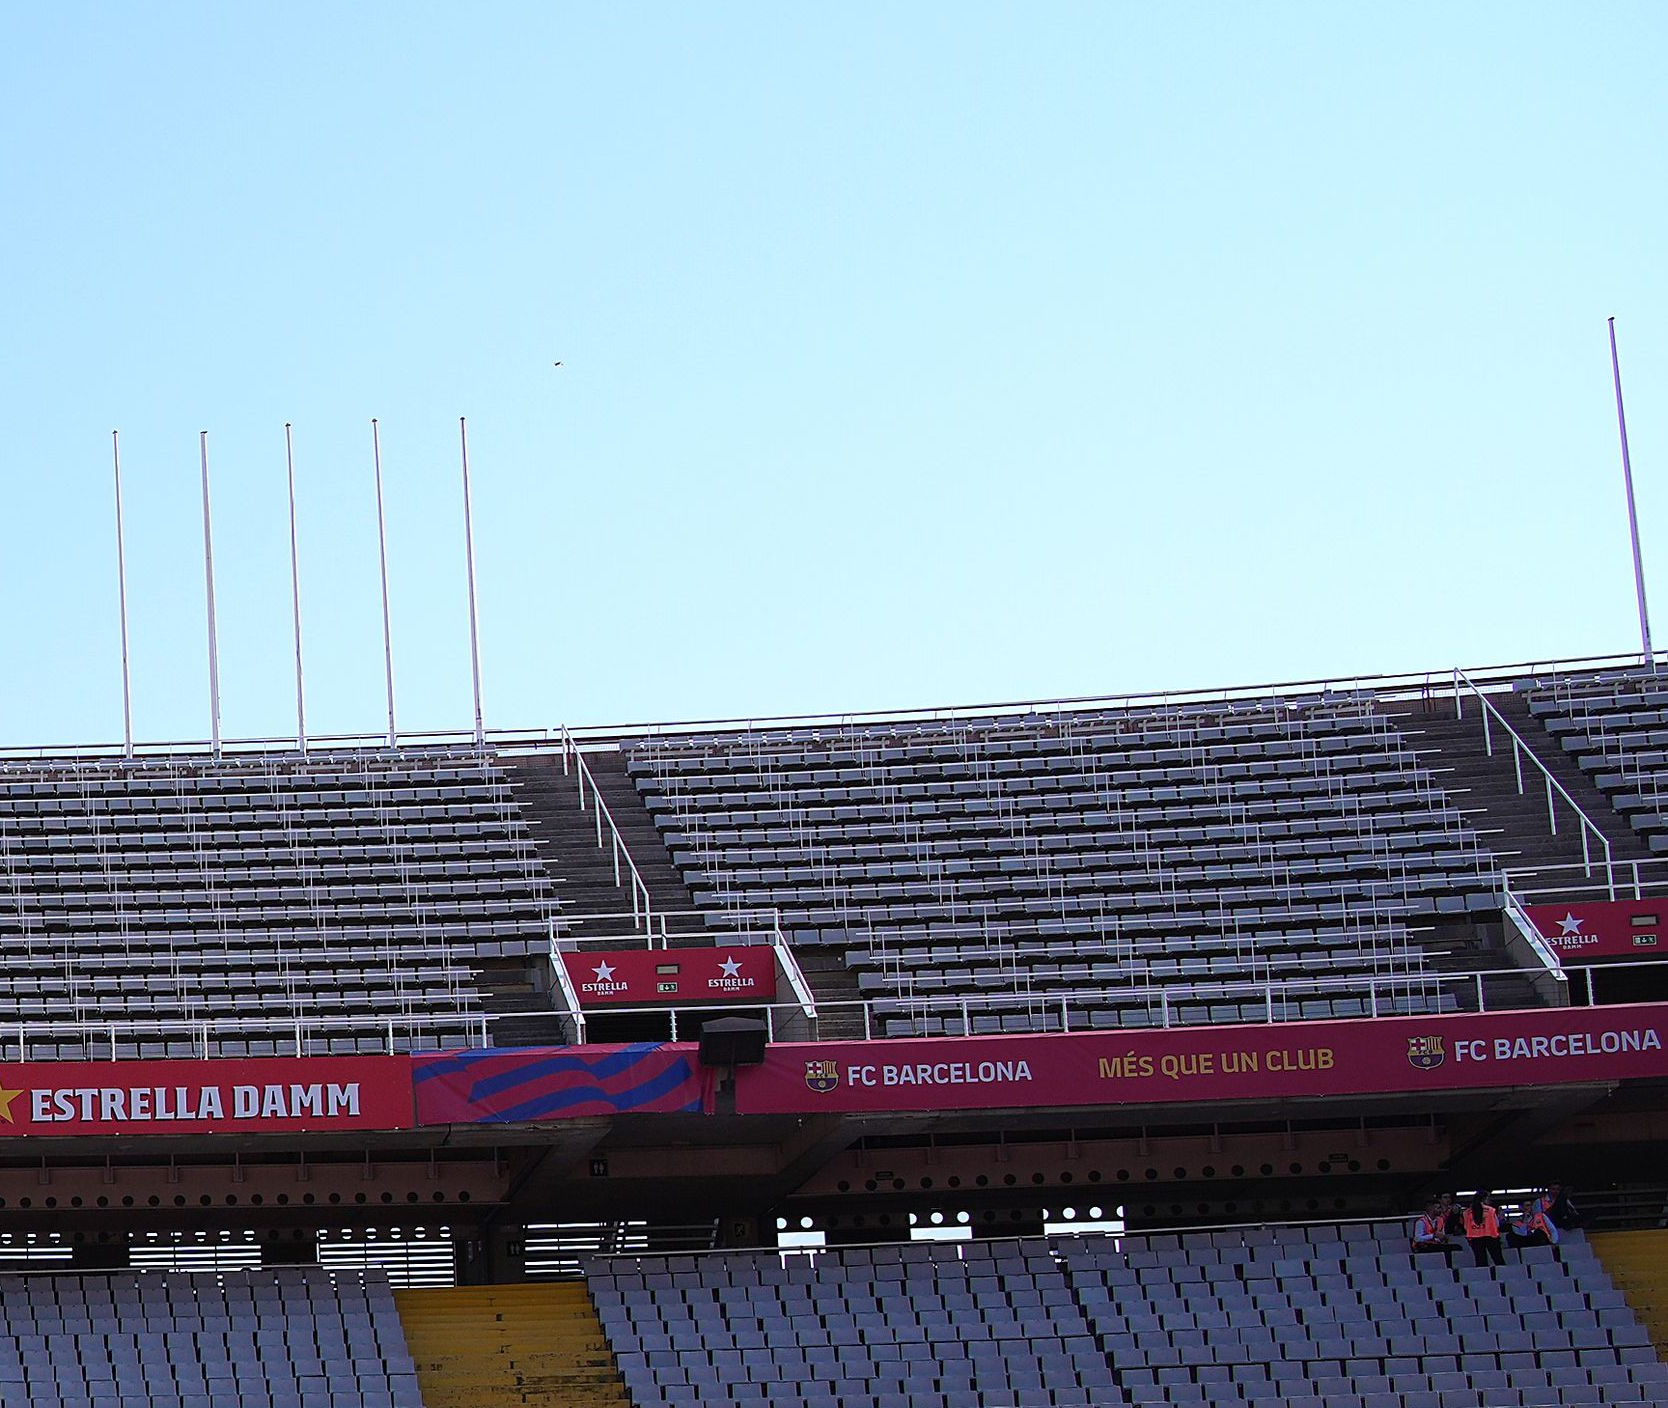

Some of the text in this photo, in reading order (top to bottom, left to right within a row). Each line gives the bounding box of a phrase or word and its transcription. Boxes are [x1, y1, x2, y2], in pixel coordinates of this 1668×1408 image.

[581, 982, 628, 992] ESTRELLA
[708, 978, 754, 988] ESTRELLA
[1454, 1029, 1662, 1062] FC BARCELONA
[847, 1060, 1033, 1087] FC BARCELONA
[1098, 1048, 1335, 1080] MÉS QUE UN CLUB
[30, 1082, 361, 1123] ESTRELLA DAMM
